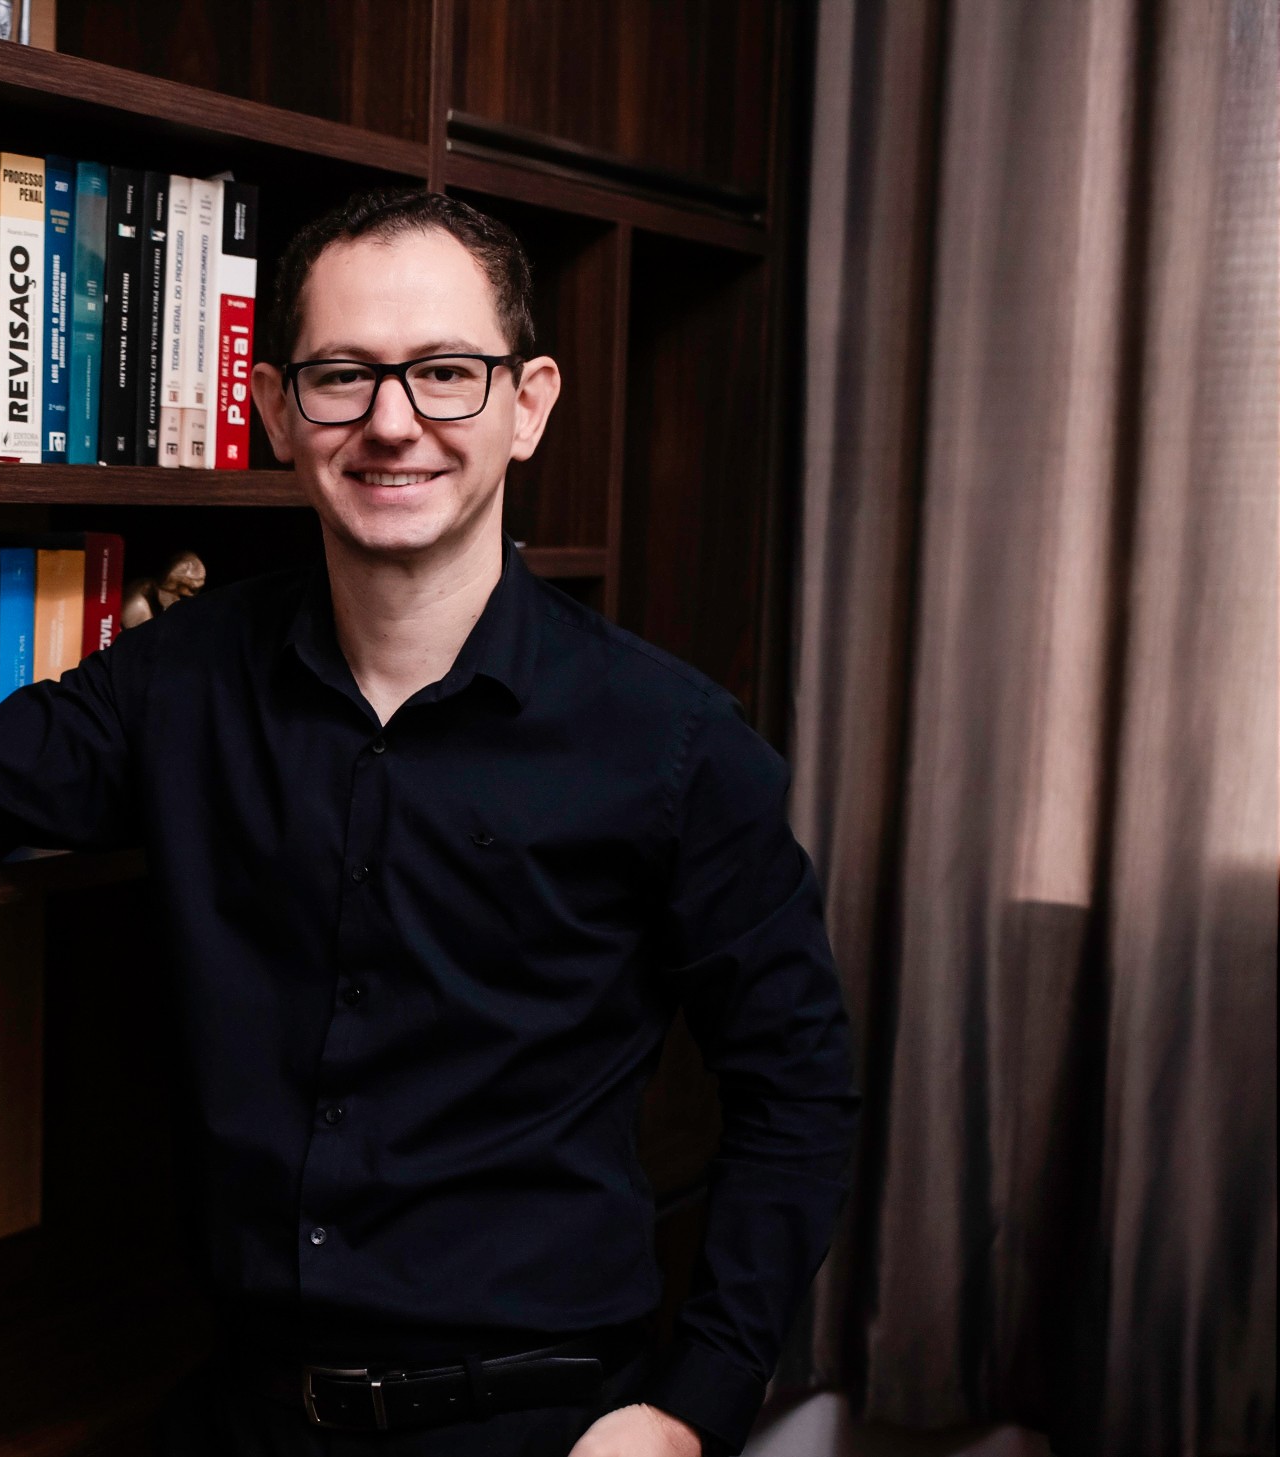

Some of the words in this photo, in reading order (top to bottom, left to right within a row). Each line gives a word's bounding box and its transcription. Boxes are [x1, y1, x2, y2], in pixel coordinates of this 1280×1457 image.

[3, 168, 43, 188] PROCESSO
[19, 187, 43, 204] PENAL
[152, 248, 161, 289] DIREITO
[175, 230, 184, 283] PROCESSO
[199, 234, 209, 307] CONHECIMENTO
[122, 272, 130, 313] DIREITO
[174, 285, 183, 300] DO
[8, 245, 37, 424] REVISAÇO
[121, 316, 128, 332] DO
[150, 290, 160, 350] PROCESSUAL
[173, 304, 182, 335] GERAL
[199, 310, 206, 323] DE
[119, 336, 128, 388] TRABALHO
[150, 354, 157, 370] DO
[171, 338, 180, 371] TEORIA
[197, 324, 205, 373] PROCESSO
[221, 335, 230, 377] MECUM
[227, 325, 249, 426] Penal
[149, 372, 157, 424] TRABALHO
[221, 381, 229, 412] VADE
